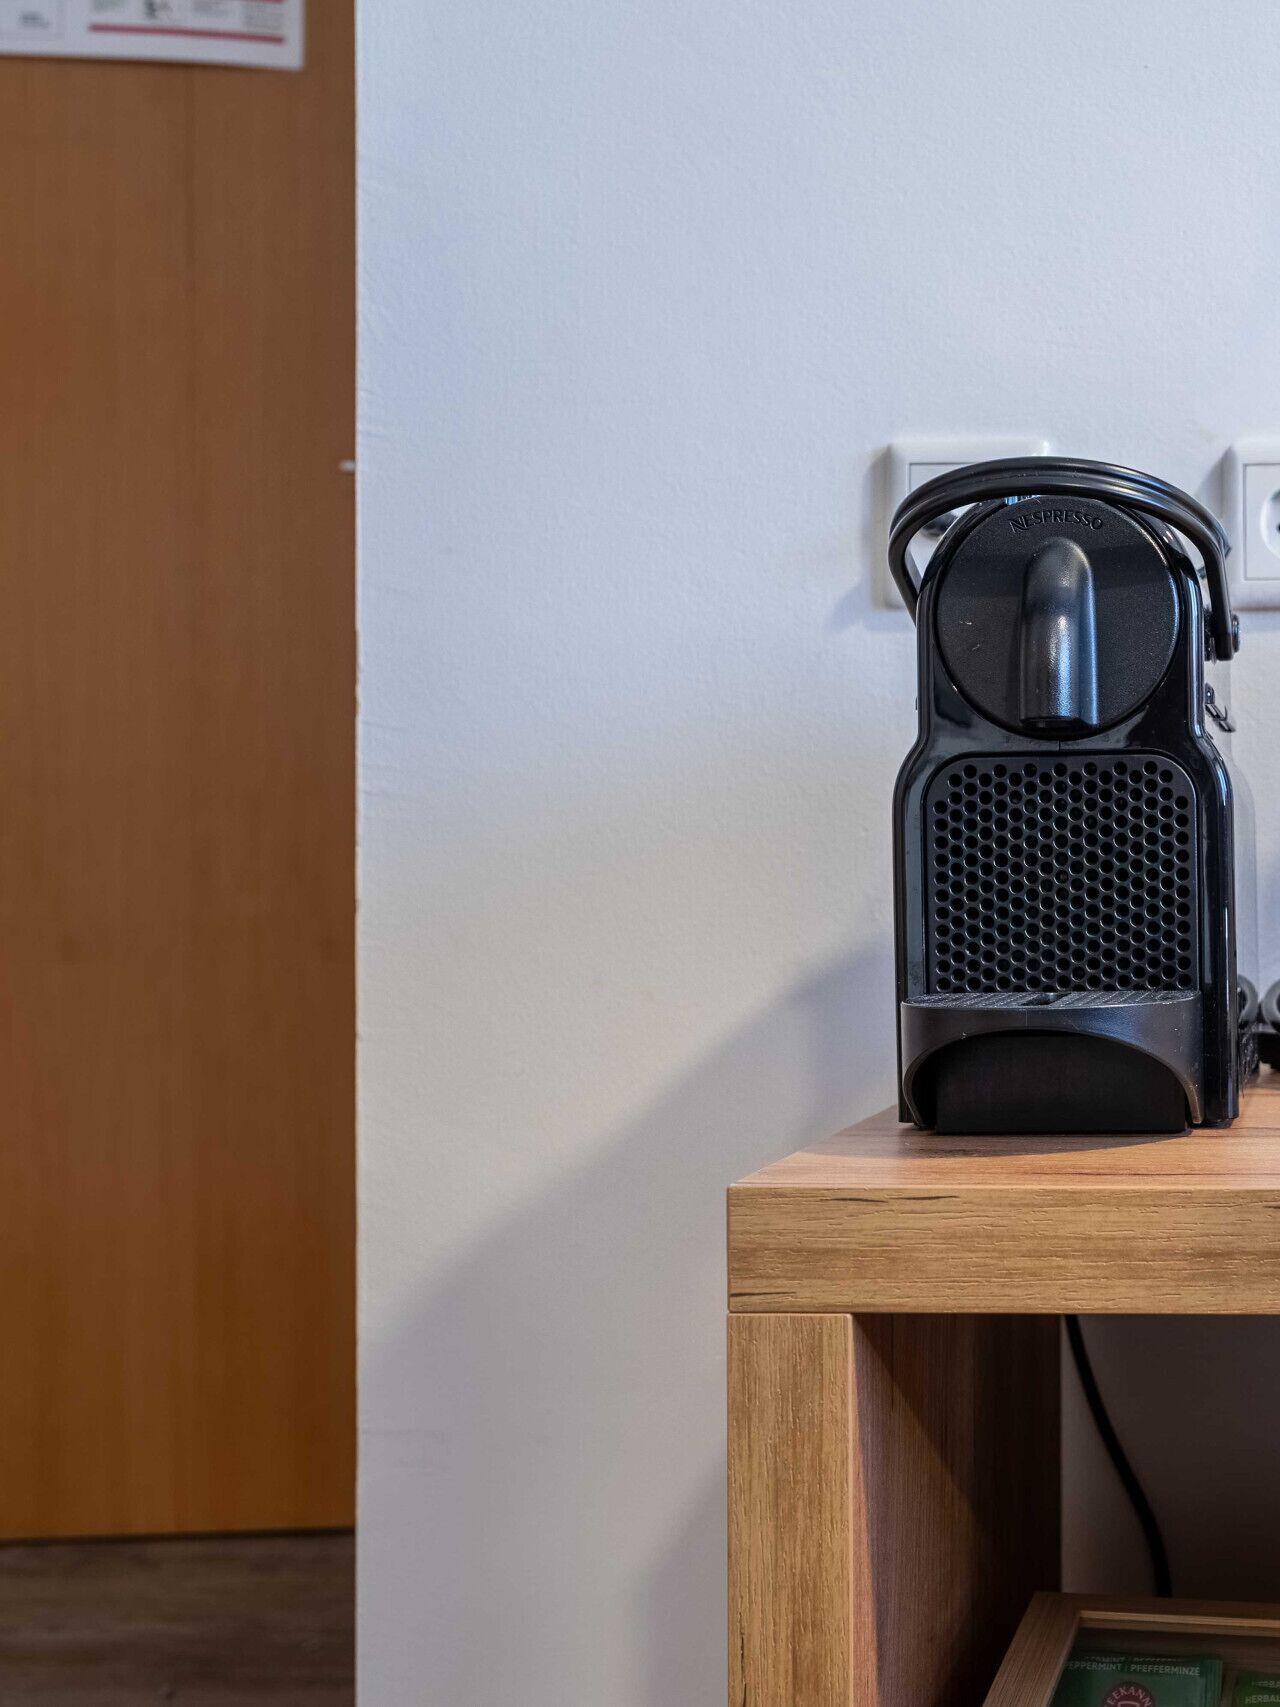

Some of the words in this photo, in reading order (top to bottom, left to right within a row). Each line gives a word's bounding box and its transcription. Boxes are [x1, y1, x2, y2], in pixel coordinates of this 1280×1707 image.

[1009, 509, 1104, 533] NESPRESSO
[1130, 1664, 1200, 1676] PFEFFERMINZE
[1245, 1694, 1280, 1704] HERBAL
